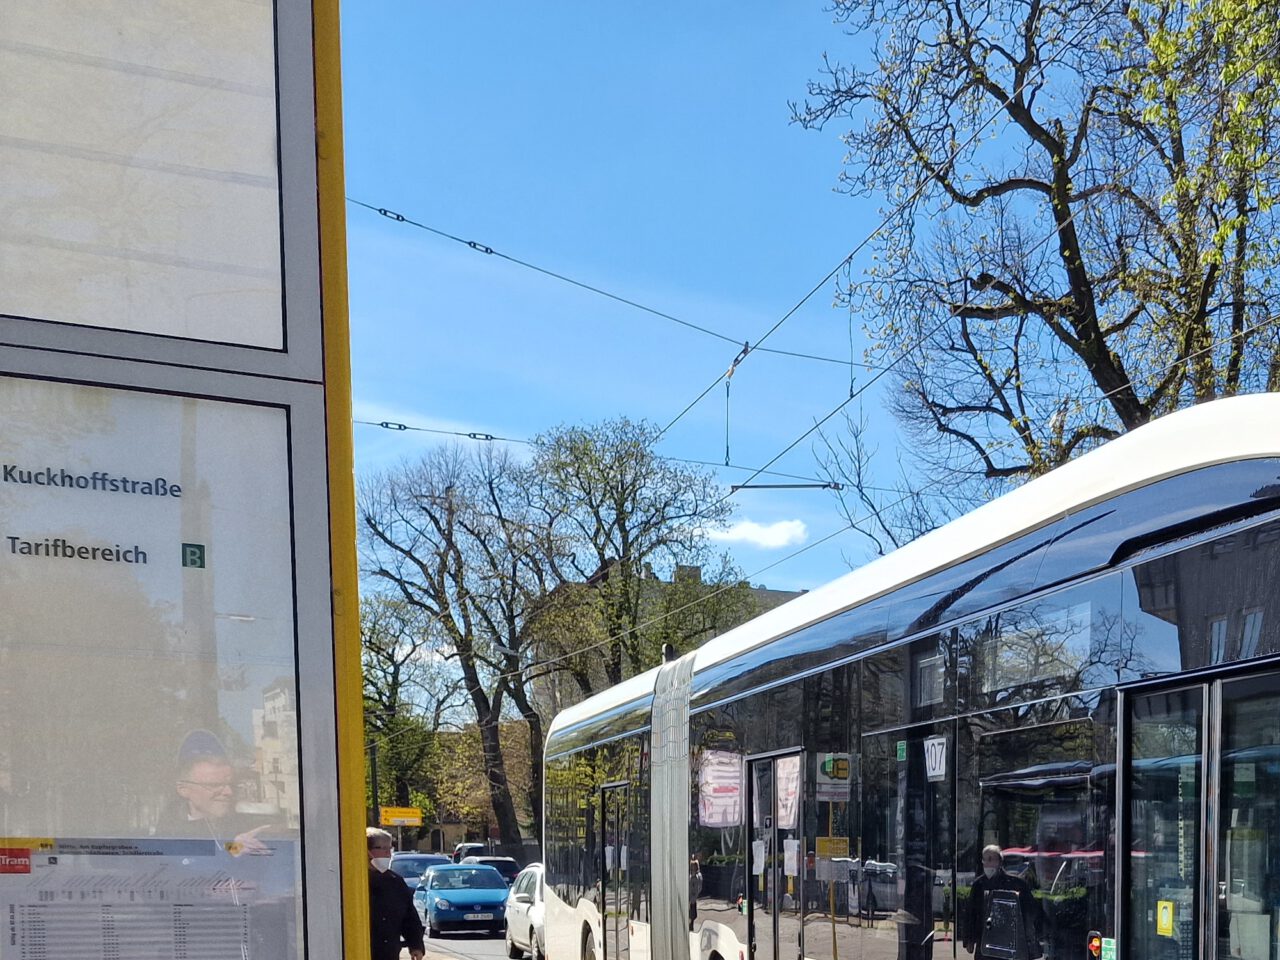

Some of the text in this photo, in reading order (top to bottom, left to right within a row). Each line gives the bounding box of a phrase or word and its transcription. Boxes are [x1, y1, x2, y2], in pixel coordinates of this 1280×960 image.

[2, 464, 182, 497] Kuckhoffstraße
[6, 536, 148, 564] Tarifbereich
[187, 548, 201, 567] B
[925, 742, 945, 772] 107
[0, 856, 30, 866] Tram
